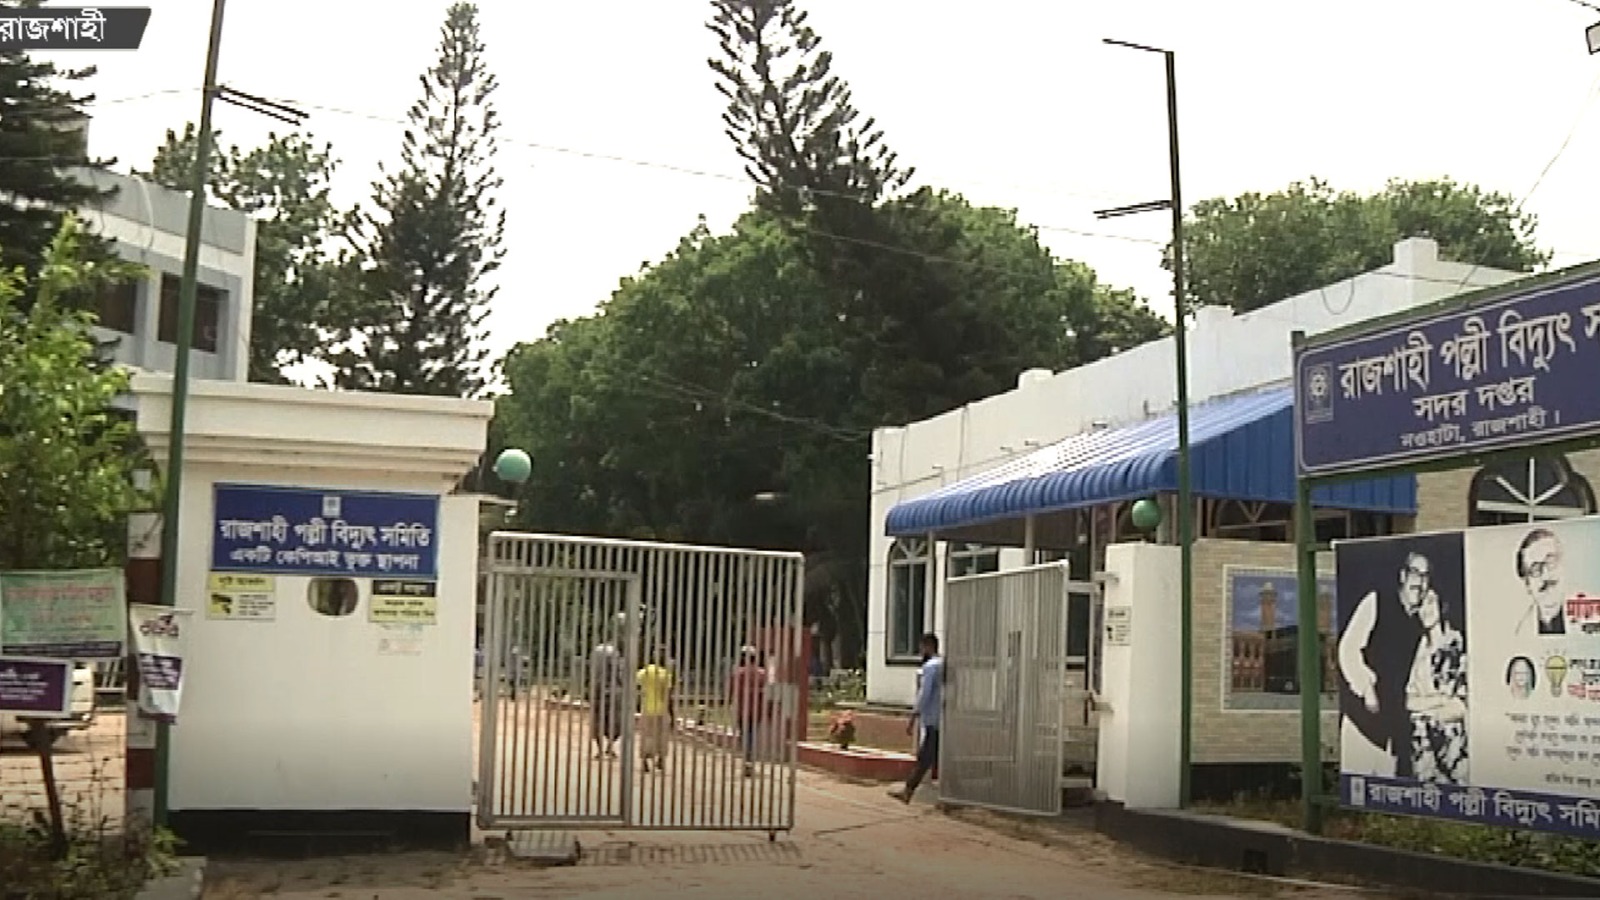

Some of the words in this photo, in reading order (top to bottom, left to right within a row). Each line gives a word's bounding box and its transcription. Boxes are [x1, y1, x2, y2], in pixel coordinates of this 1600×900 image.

[1339, 330, 1433, 399] রাজশাহী
[1440, 316, 1491, 381] পল্লী
[1498, 310, 1576, 372] বিদ্যুৎ
[1412, 389, 1470, 422] সদর
[1475, 376, 1536, 412] দপ্তর
[1470, 405, 1547, 437] রাজশাহী
[219, 515, 289, 544] রাজশাহী
[294, 517, 329, 546] পল্লী
[331, 520, 377, 551] বিদ্যুৎ
[379, 522, 432, 548] সমিতি
[230, 546, 272, 564] একটি
[1369, 783, 1442, 812] রাজশাহী
[1449, 787, 1487, 816] পল্লী
[1494, 791, 1553, 826] বিদ্যুৎ
